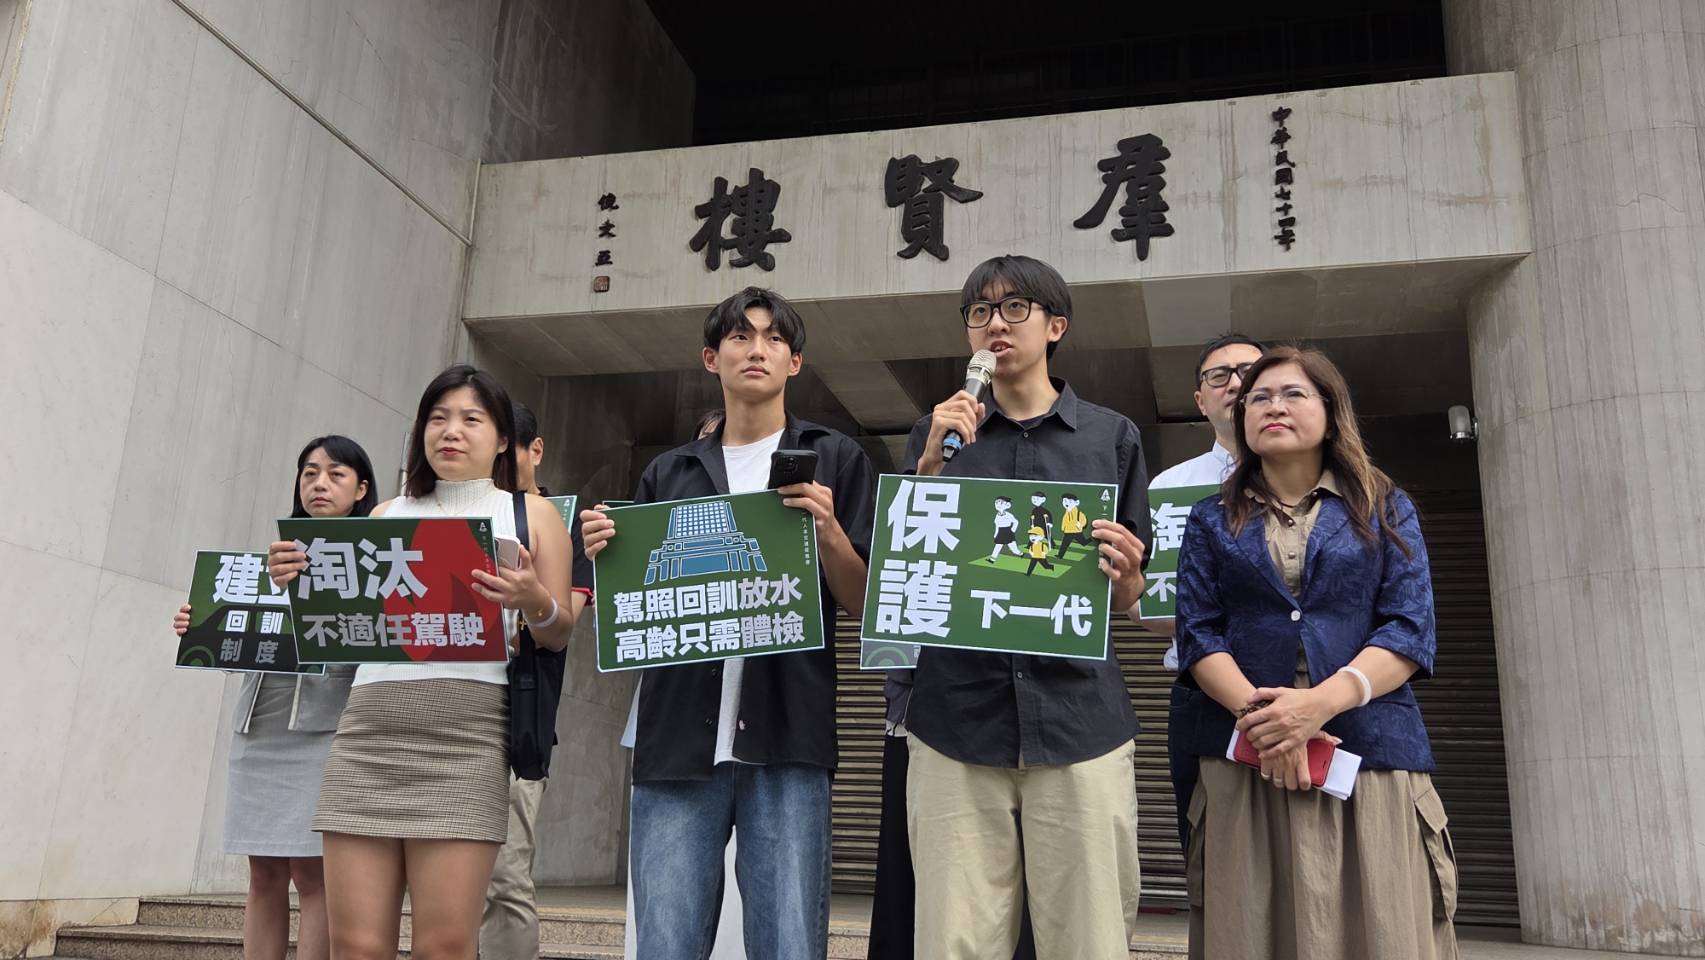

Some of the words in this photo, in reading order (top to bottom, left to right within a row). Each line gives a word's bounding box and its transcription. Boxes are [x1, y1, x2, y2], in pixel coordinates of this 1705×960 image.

[1270, 106, 1296, 252] 中華民國七十四年
[294, 537, 428, 600] 淘汰
[875, 479, 962, 638] 保護
[225, 610, 284, 635] 回訓
[613, 573, 803, 625] 駕照回訓放水
[970, 589, 1093, 637] 下一代
[220, 637, 279, 664] 制度
[301, 612, 487, 648] 不適任駕駛
[614, 610, 806, 663] 高齡只需體檢
